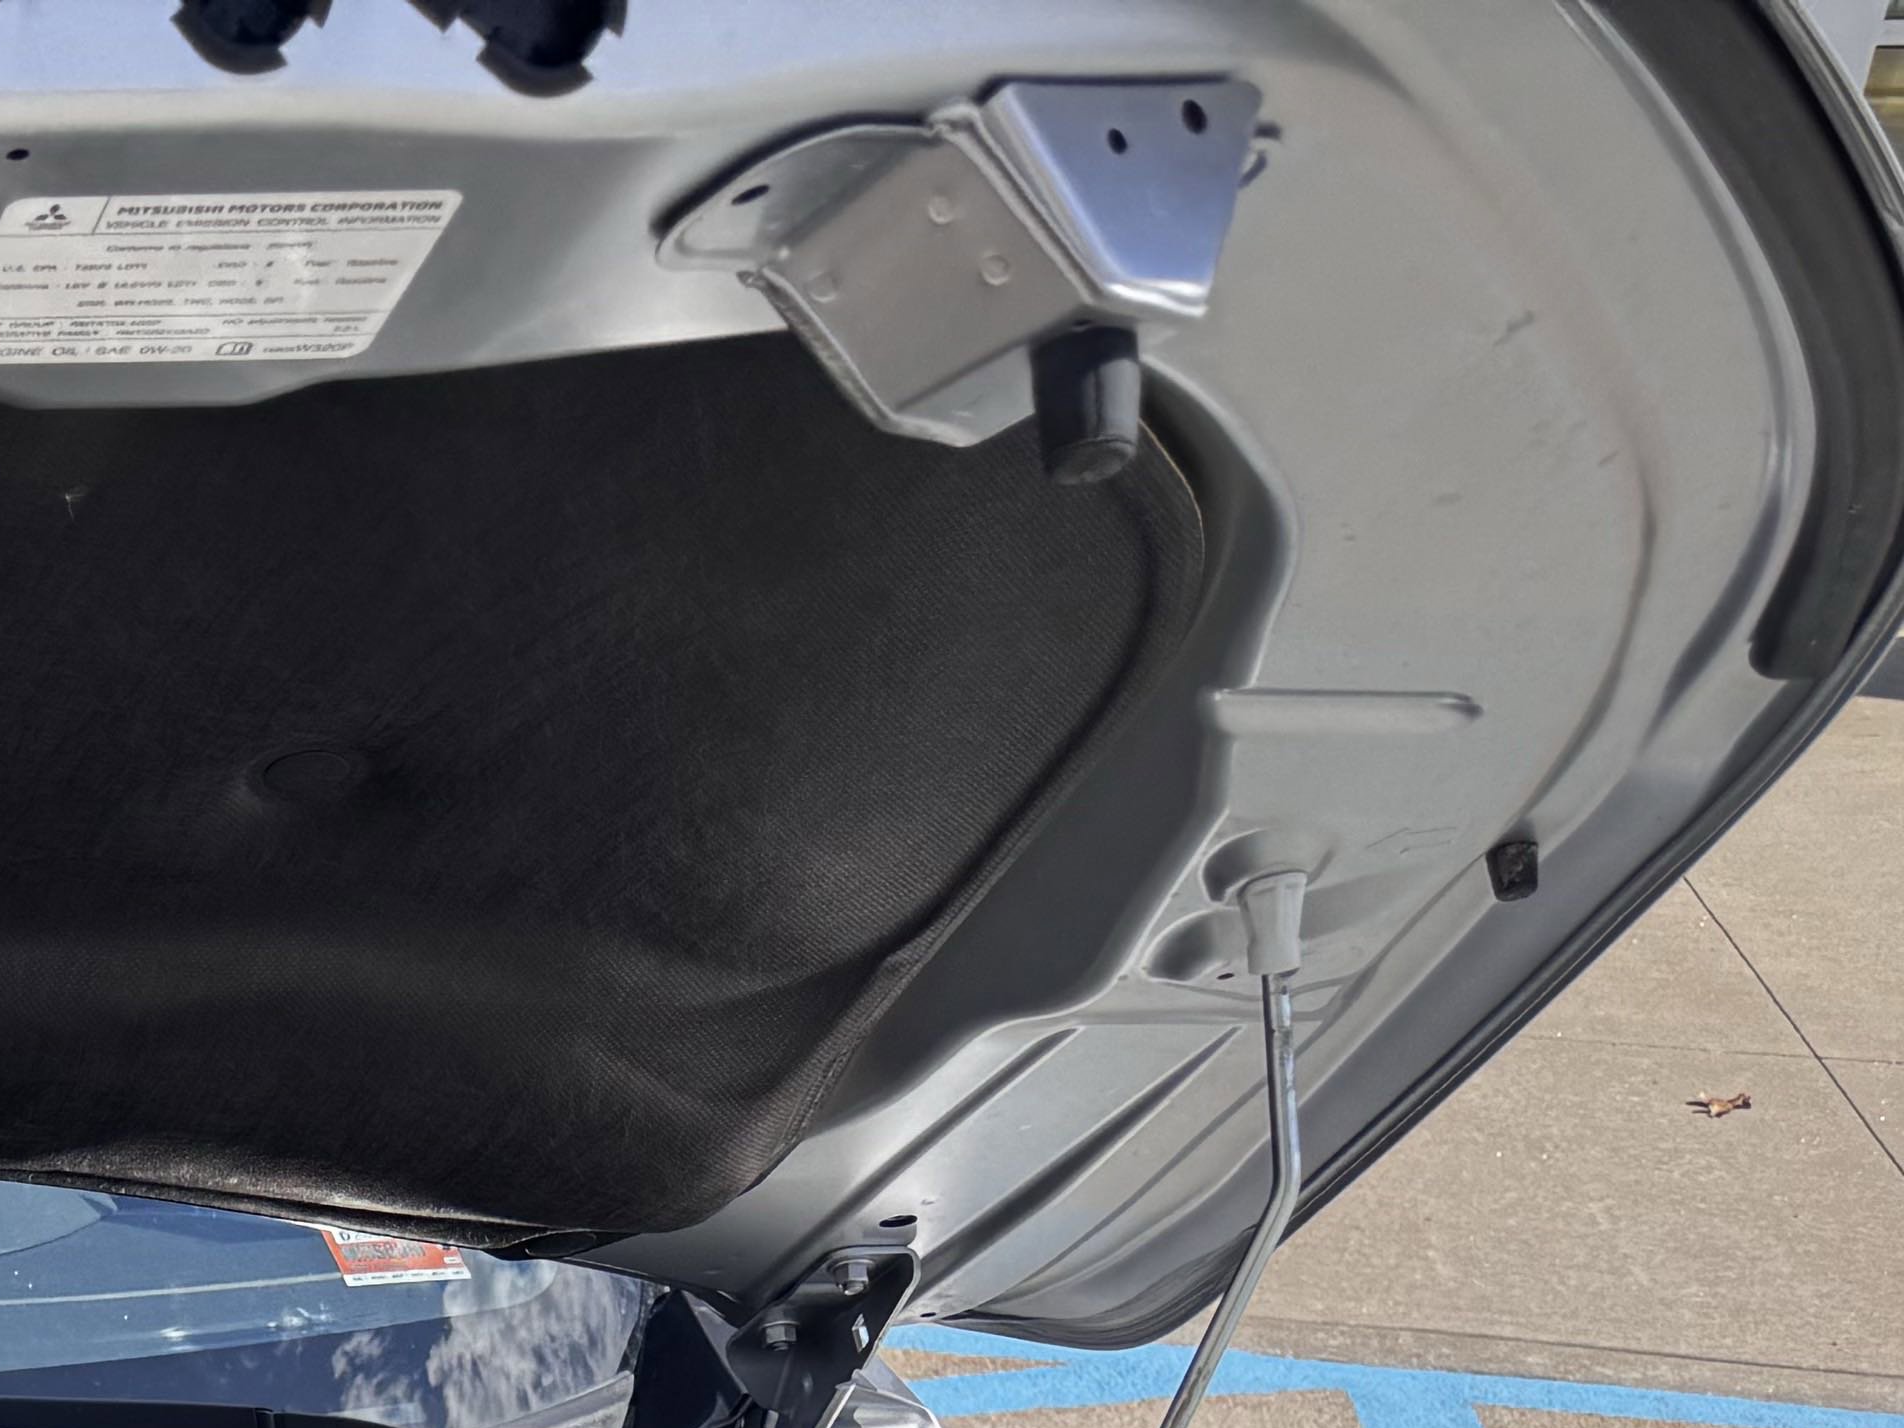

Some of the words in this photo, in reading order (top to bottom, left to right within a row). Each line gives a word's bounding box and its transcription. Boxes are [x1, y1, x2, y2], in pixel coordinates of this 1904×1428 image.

[117, 204, 224, 215] MITSUBISHI
[228, 203, 306, 214] MOTORS
[310, 201, 444, 212] CORPORATION
[106, 219, 168, 230] VEHICLE
[175, 218, 250, 228] EMISSION
[257, 217, 328, 226] CONTROL
[337, 215, 442, 224] INFORMATION
[52, 347, 79, 357] OIL
[95, 346, 132, 356] SAE
